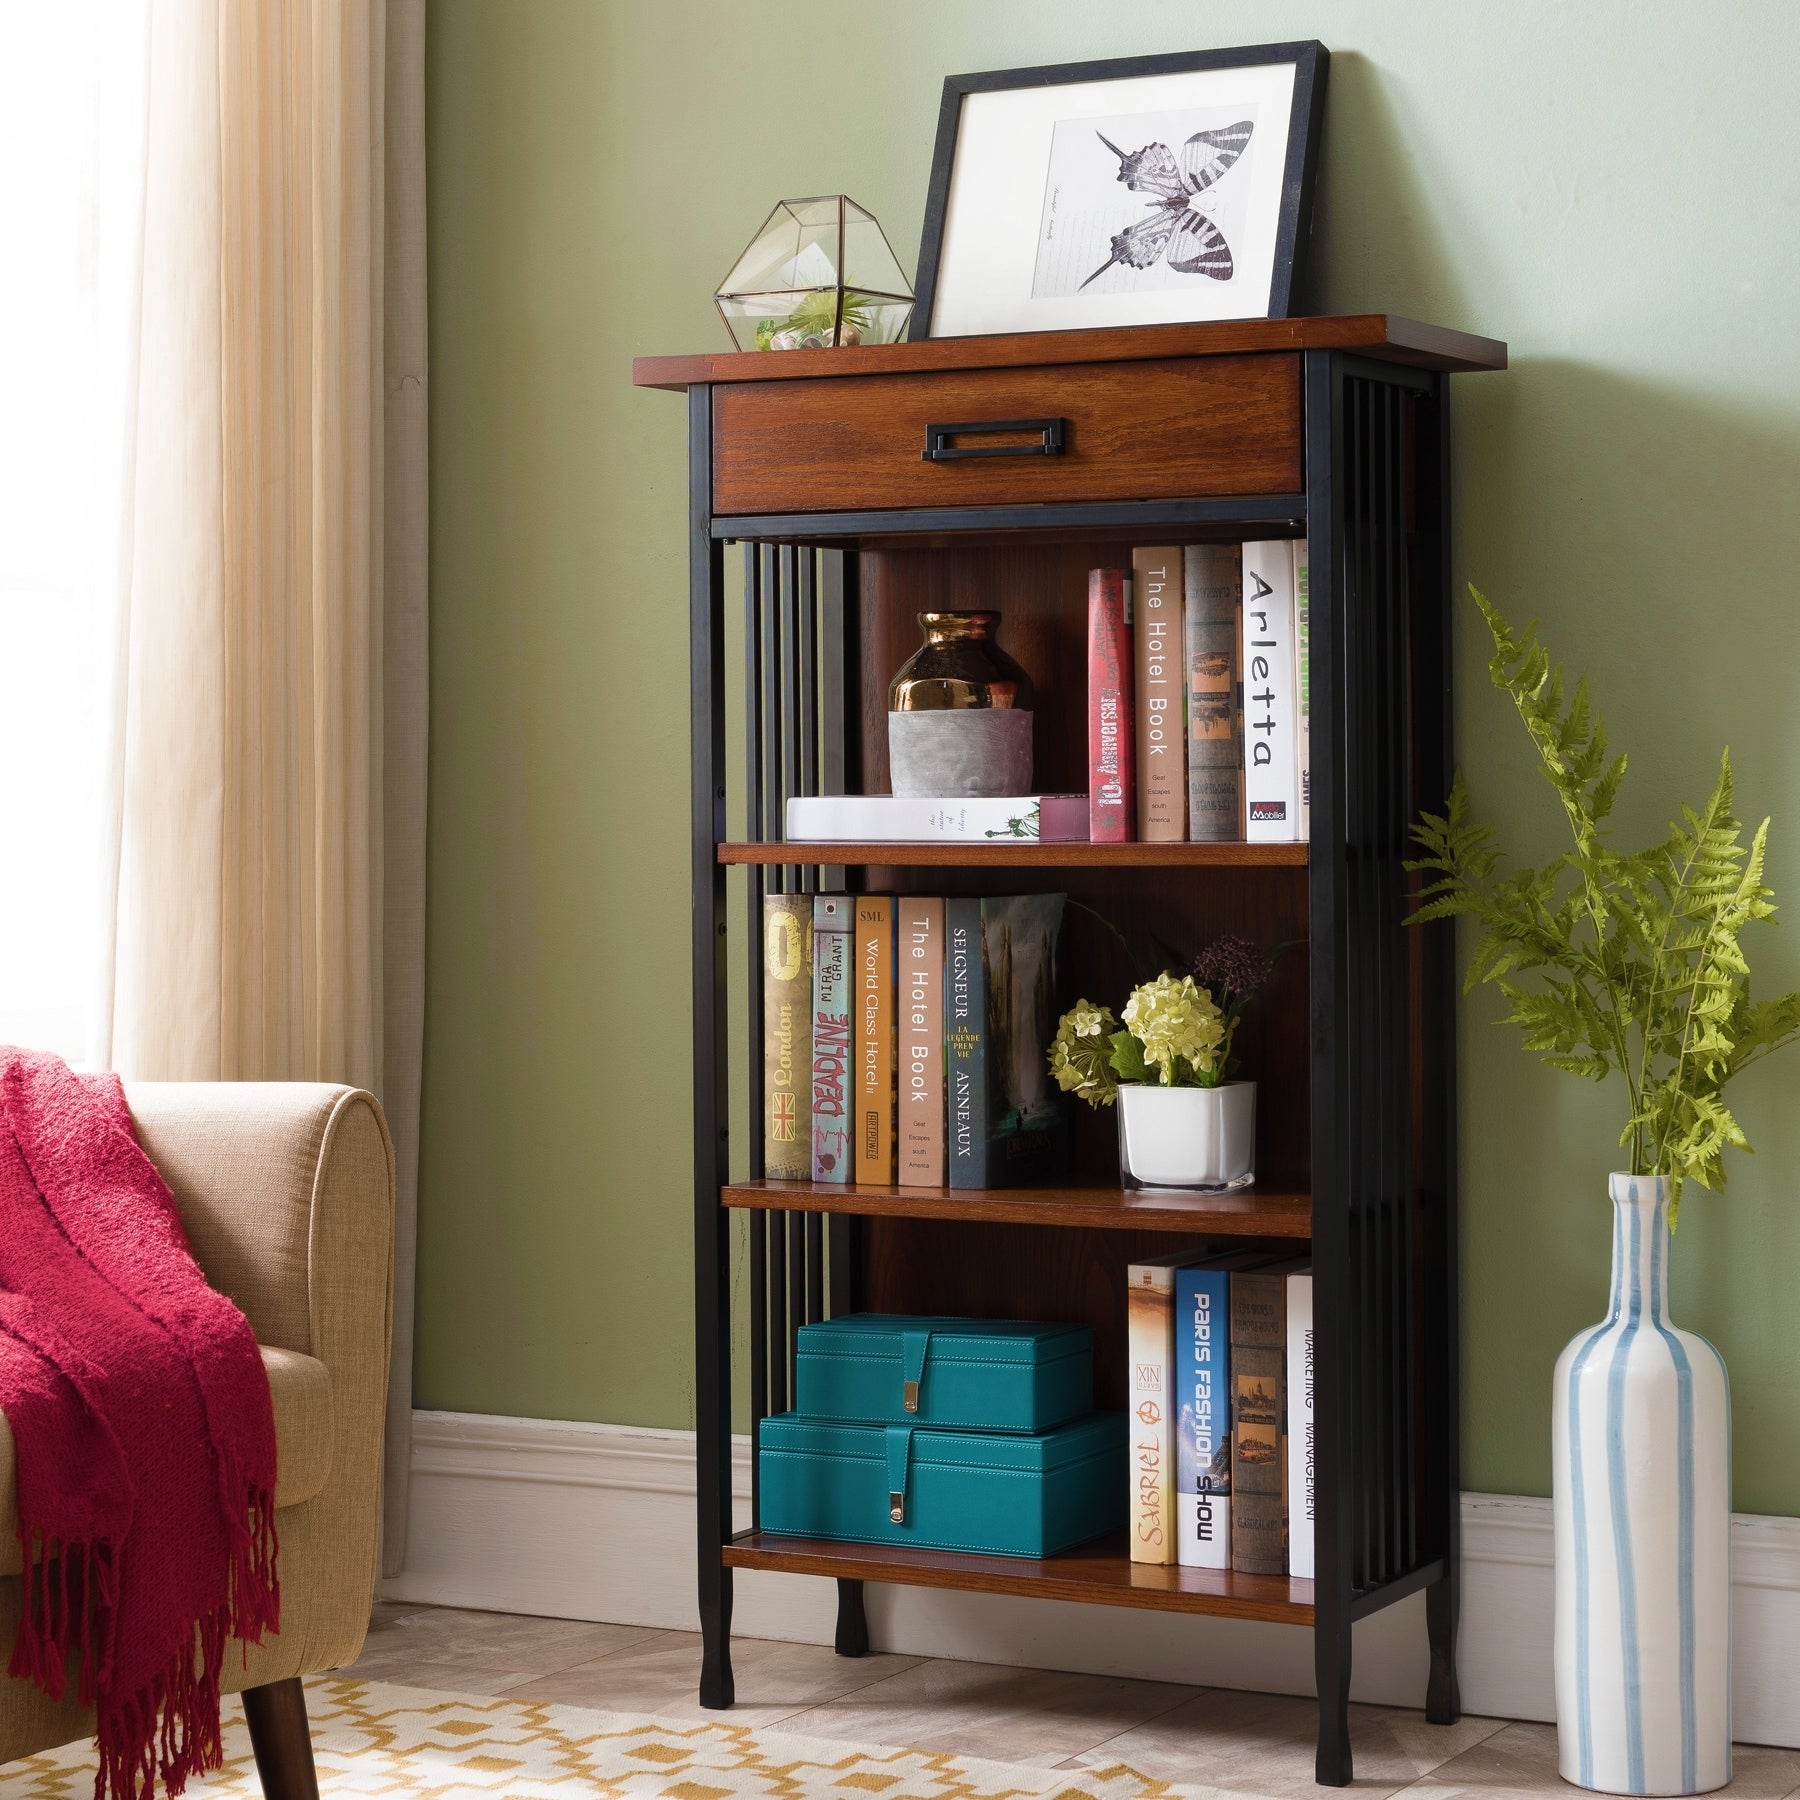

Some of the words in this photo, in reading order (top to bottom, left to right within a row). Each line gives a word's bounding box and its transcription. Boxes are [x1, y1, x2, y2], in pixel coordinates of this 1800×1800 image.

[1148, 566, 1166, 609] The
[1094, 607, 1106, 660] JAMES
[1103, 585, 1120, 682] PATTERSON
[1148, 622, 1167, 684] Hotel
[1250, 570, 1277, 767] Arletta
[1097, 687, 1121, 774] Anniversary
[1150, 698, 1168, 756] Book
[1147, 788, 1171, 796] Escapes
[860, 910, 885, 922] SML
[912, 917, 929, 958] The
[821, 965, 833, 1002] MIRA
[832, 936, 843, 981] GRANT
[866, 938, 879, 989] World
[953, 928, 968, 1019] SEIGNEUR
[866, 993, 879, 1036] Class
[912, 972, 929, 1033] Hotel
[773, 1002, 793, 1088] London
[813, 1011, 850, 1117] DEADLINE
[866, 1041, 879, 1086] Hotel
[911, 1046, 929, 1102] Book
[867, 1113, 878, 1160] ARTPOWER
[908, 1134, 930, 1142] Escapes
[956, 1070, 971, 1157] ANNEAUX
[908, 1161, 930, 1169] America
[1194, 1292, 1211, 1363] PARIS
[1137, 1366, 1160, 1383] NIX
[1304, 1329, 1314, 1409] MARKETING
[1195, 1369, 1212, 1468] FASHION
[1137, 1432, 1164, 1546] SABRIEL
[1305, 1422, 1315, 1520] MANAGEMENT
[1196, 1475, 1213, 1541] SHOW
